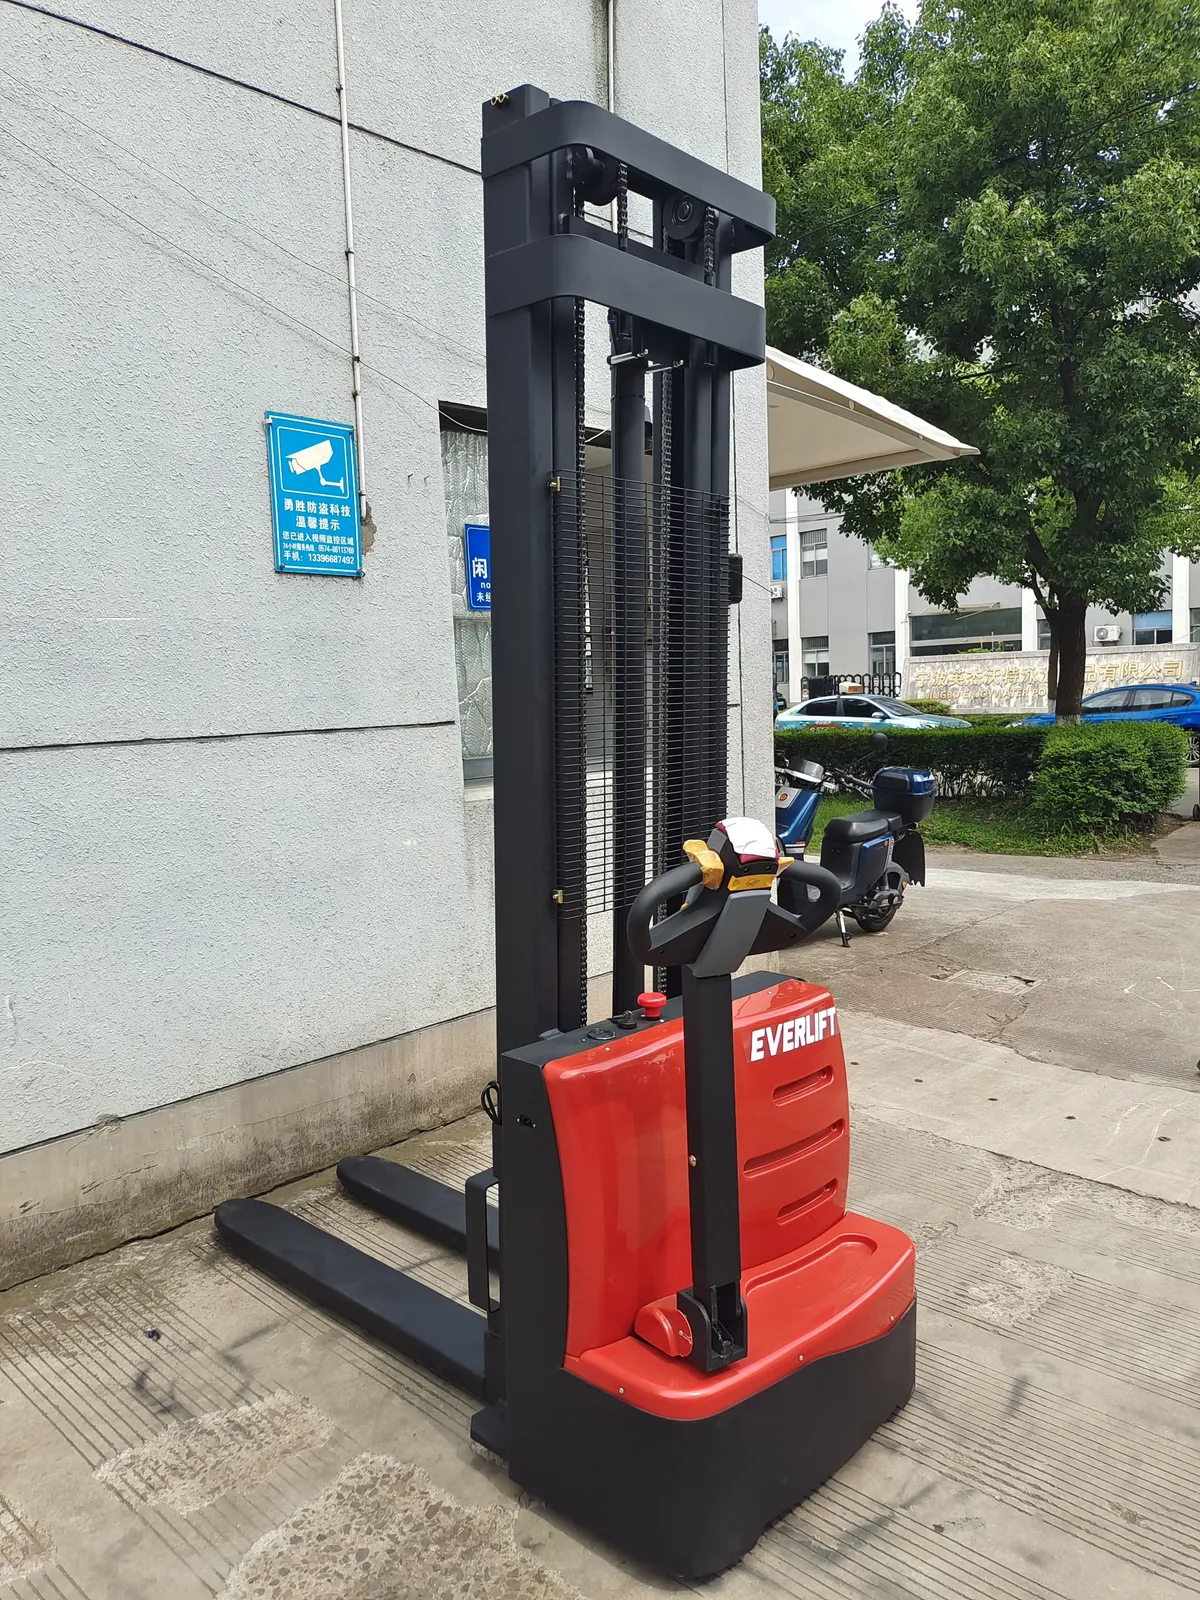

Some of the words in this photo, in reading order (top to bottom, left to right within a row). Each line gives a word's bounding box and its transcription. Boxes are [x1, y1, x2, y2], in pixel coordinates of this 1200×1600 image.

[284, 498, 351, 517] 勇胜防盗科技
[296, 515, 340, 531] 温馨提示
[282, 531, 354, 546] 您已进入视频监控区域
[308, 553, 355, 565] 13396687492
[472, 557, 488, 579] 闲
[751, 1006, 836, 1062] EVERLIFT
